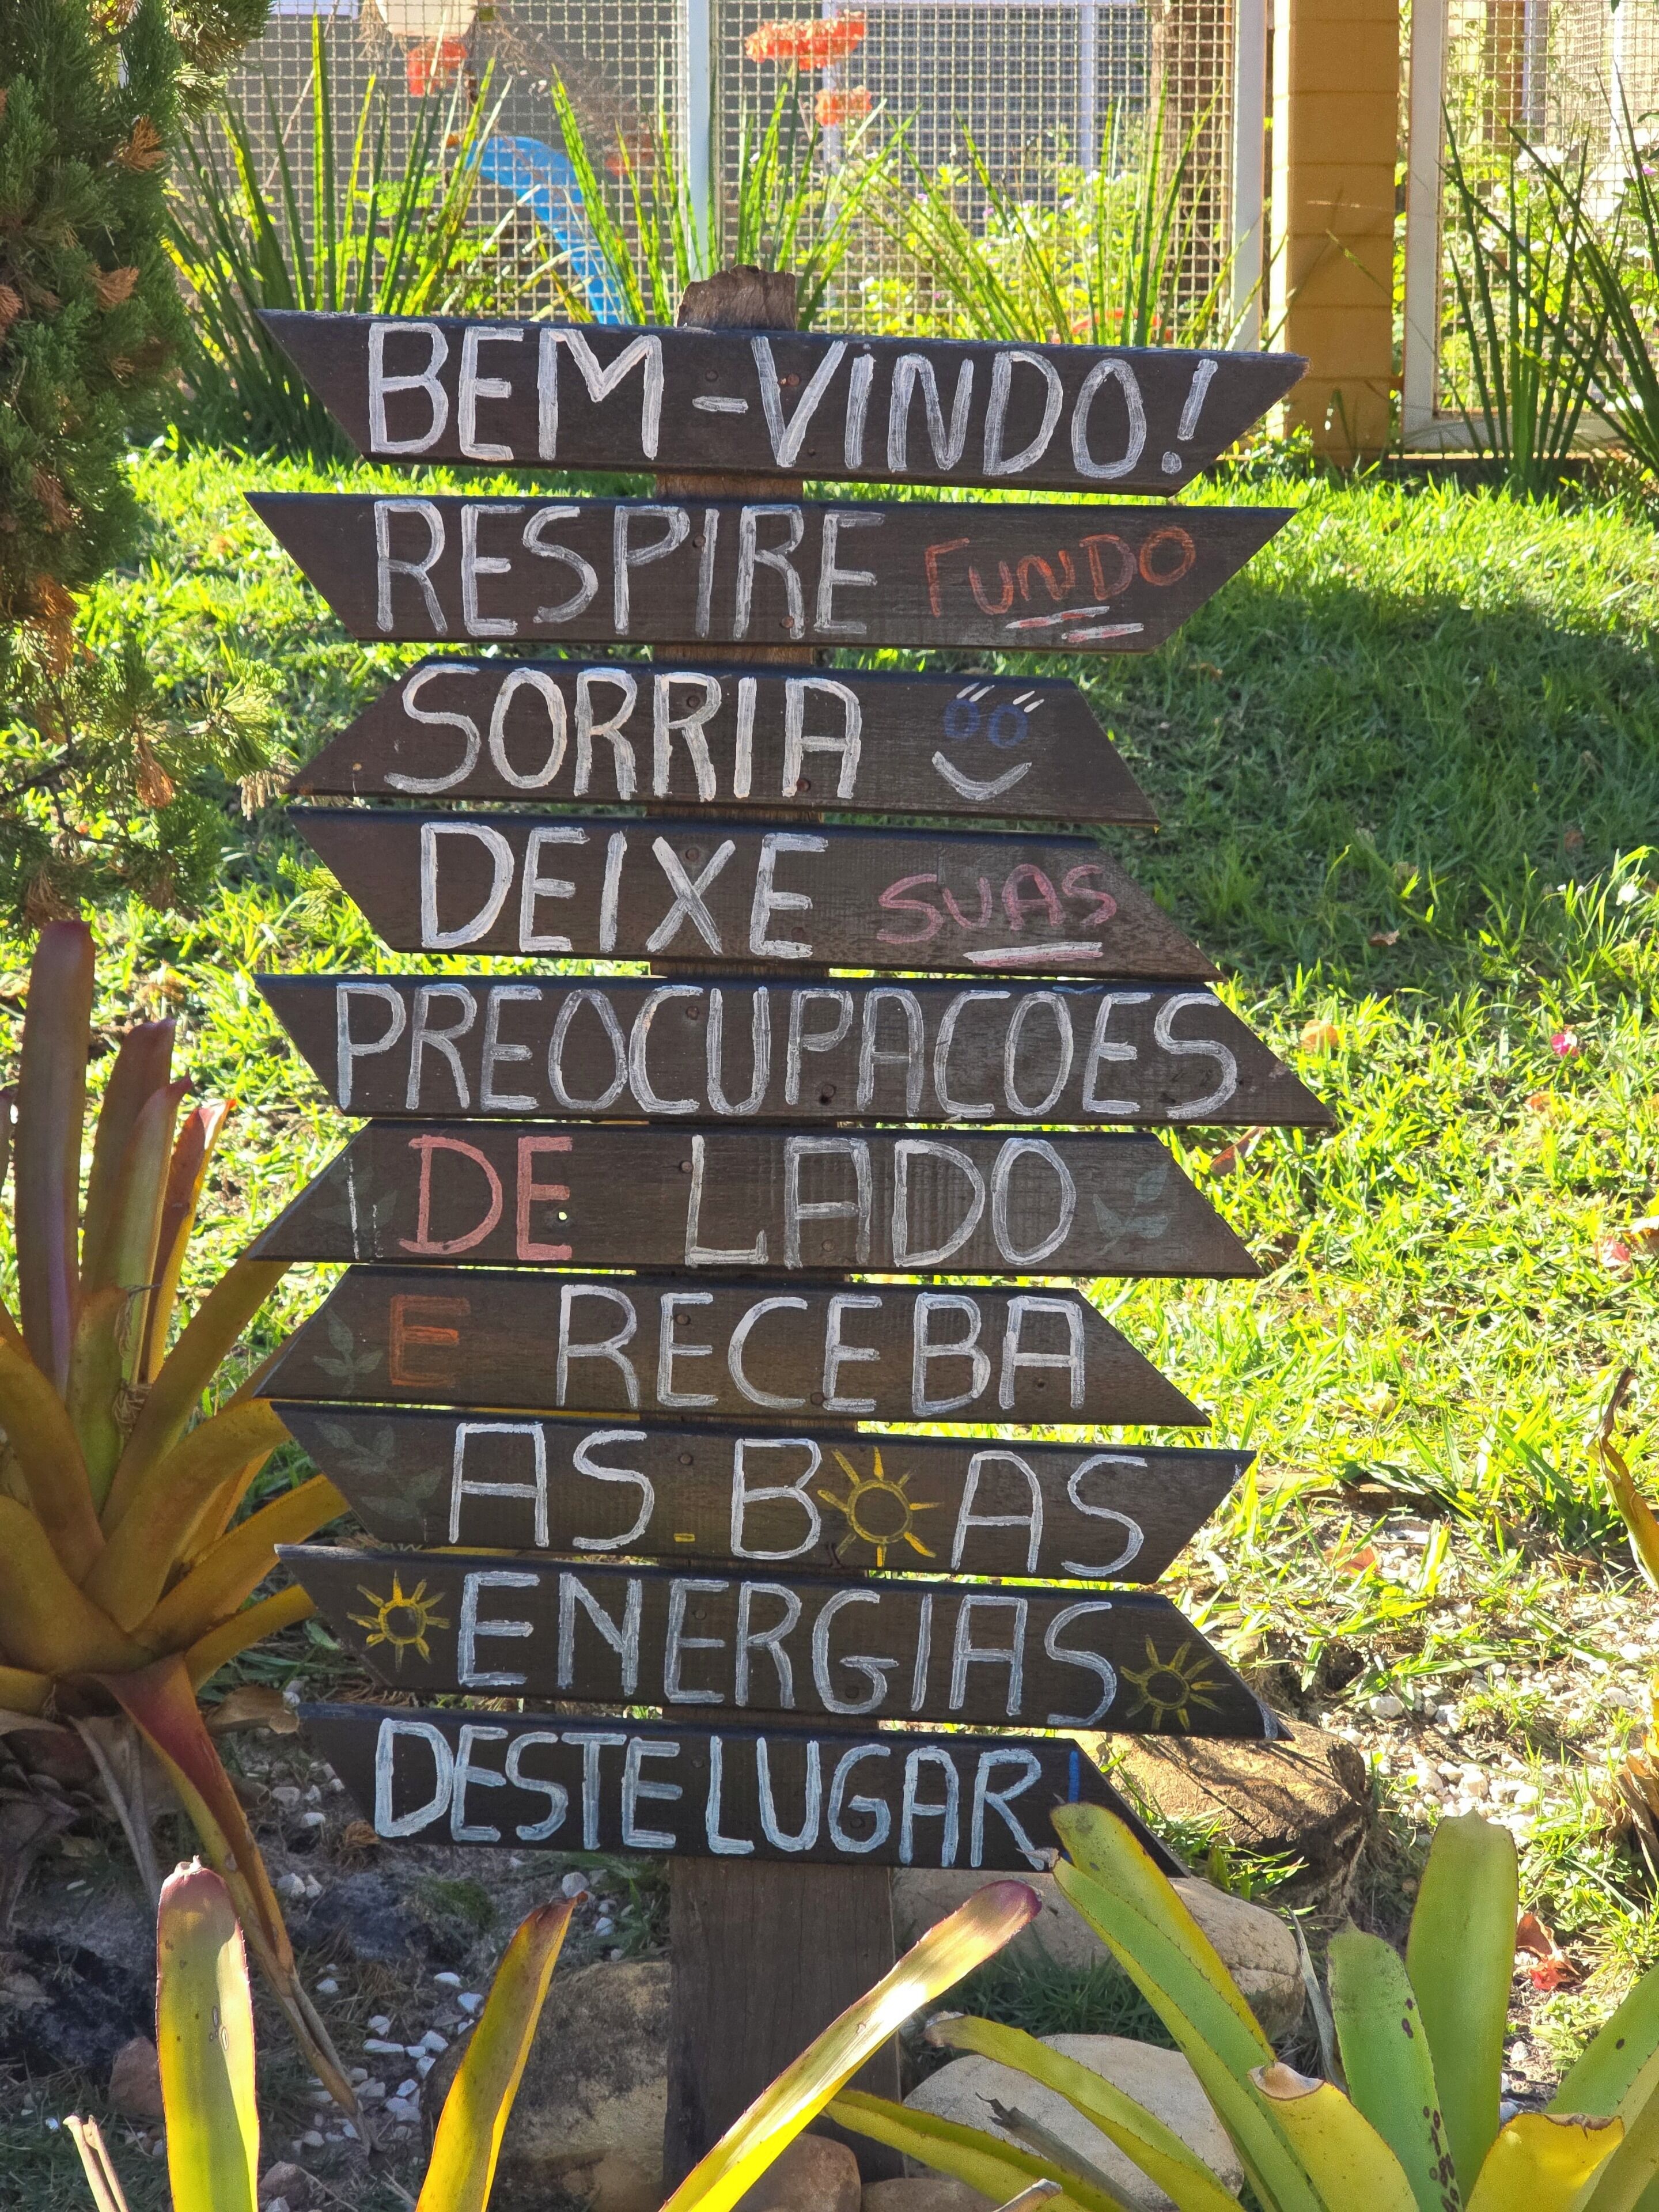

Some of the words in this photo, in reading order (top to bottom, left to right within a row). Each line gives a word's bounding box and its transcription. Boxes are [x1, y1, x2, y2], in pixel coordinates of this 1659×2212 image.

[373, 499, 885, 641] RESPIRE
[923, 525, 1197, 619] FUNDO
[385, 662, 863, 803] SORRIA
[419, 821, 830, 960] DEIXE
[876, 864, 1119, 946] SUAS
[399, 1134, 574, 1260] DE
[683, 1135, 1077, 1268] LADO
[389, 1294, 471, 1388] E
[556, 1283, 1085, 1418] RECEBA
[449, 1422, 654, 1552] AS
[457, 1570, 1118, 1728] ENERGIAS
[374, 1718, 682, 1853] DESTE
